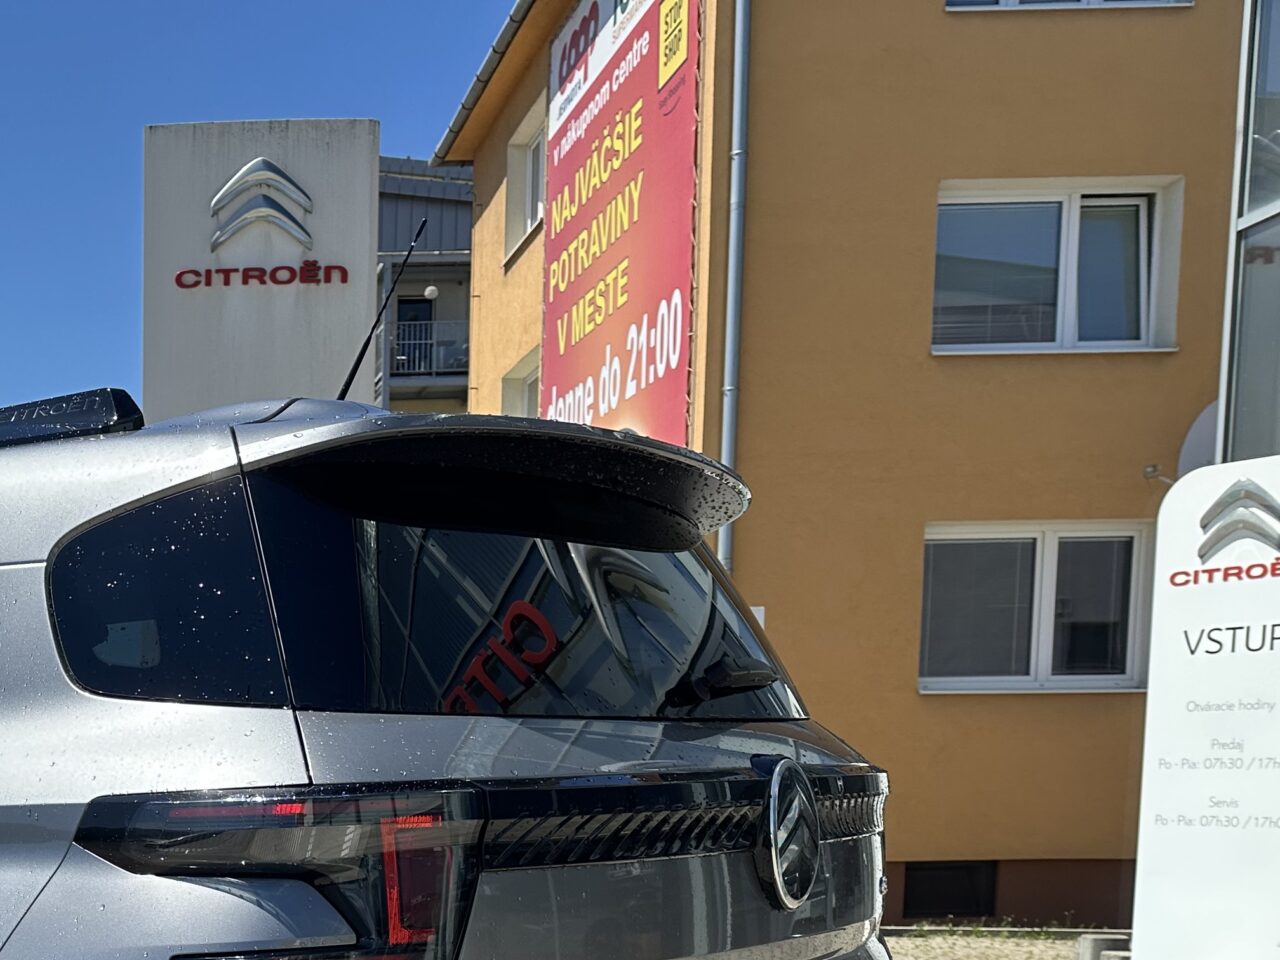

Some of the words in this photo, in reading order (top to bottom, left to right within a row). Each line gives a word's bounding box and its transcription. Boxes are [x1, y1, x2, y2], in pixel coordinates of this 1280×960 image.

[664, 0, 683, 35] STOP
[664, 28, 683, 66] SHOP
[554, 146, 560, 167] v
[560, 80, 610, 159] nákupnom
[612, 31, 650, 92] centre
[551, 98, 644, 239] NAJVÄČŠIE
[549, 170, 644, 303] POTRAVINY
[175, 260, 348, 289] CITROËN
[557, 312, 569, 356] V
[571, 257, 630, 346] MESTE
[599, 344, 621, 417] do
[625, 288, 682, 400] 21:00
[1184, 623, 1280, 656] VSTUP
[1238, 698, 1276, 713] hodiny
[1211, 738, 1244, 753] Predaj
[1203, 757, 1244, 770] 07h30
[1208, 795, 1240, 809] Servis
[1200, 815, 1240, 828] 07h30
